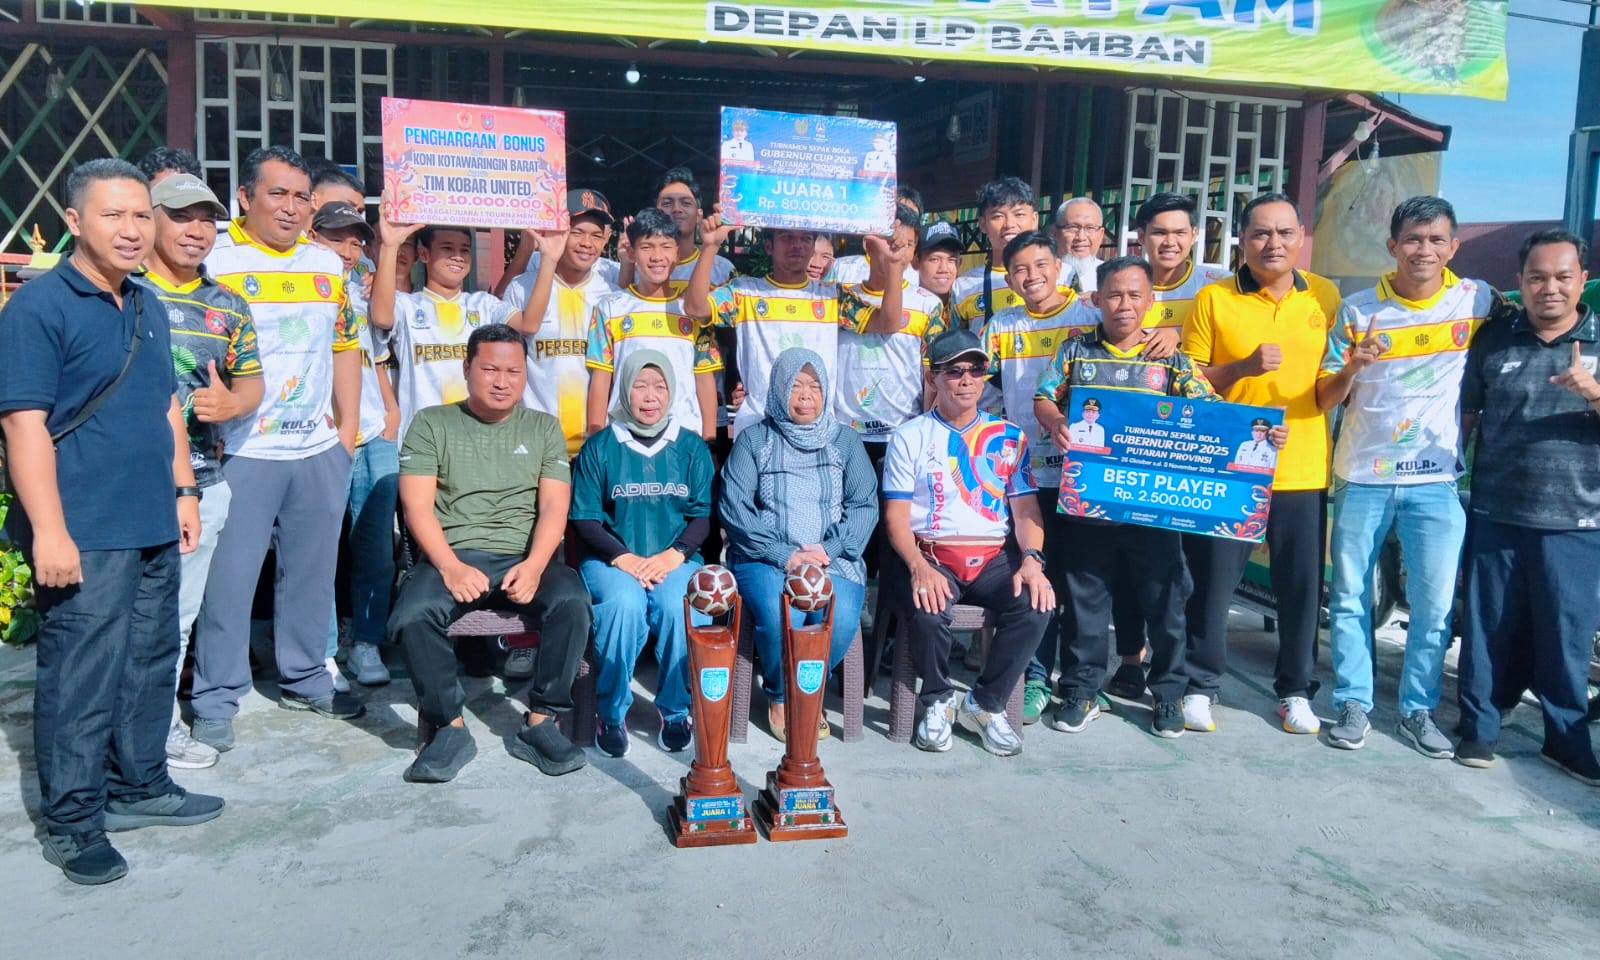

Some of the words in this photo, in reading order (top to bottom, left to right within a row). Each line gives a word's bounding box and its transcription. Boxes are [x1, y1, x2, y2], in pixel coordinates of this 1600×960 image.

[714, 5, 898, 42] DEPAN
[915, 20, 976, 47] LP
[991, 25, 1206, 64] BAMBAN
[405, 127, 497, 150] PENGHARGAAN
[503, 135, 545, 153] BONUS
[413, 152, 436, 166] KONI
[437, 154, 508, 171] KOTAWARINGIN
[510, 159, 539, 173] BARAT
[760, 149, 812, 161] GUBERNUR
[813, 153, 833, 162] CUP
[834, 155, 859, 165] 2025
[424, 175, 444, 191] TIM
[447, 177, 488, 194] KOBAR
[490, 180, 531, 196] UNITED
[771, 180, 835, 199] JUARA
[839, 185, 848, 200] 1
[411, 193, 442, 206] Rp.
[447, 195, 542, 210] 10.000.000
[758, 197, 778, 210] Rp.
[782, 199, 859, 214] 80.000.000
[454, 209, 478, 217] JUARA
[1112, 433, 1174, 450] GUBERNUR
[1174, 441, 1199, 452] CUP
[1198, 444, 1230, 457] 2025
[1124, 426, 1169, 438] TURNAMEN
[1169, 431, 1196, 441] SEPAK
[1198, 434, 1220, 444] BOLA
[1126, 446, 1168, 459] PUTARAN
[1169, 452, 1213, 465] PROVINSI
[611, 482, 689, 499] ADIDAS
[1103, 467, 1150, 489] BEST
[1154, 473, 1228, 498] PLAYER
[929, 471, 945, 531] POPNAS
[1113, 487, 1135, 502] Rp.
[1138, 489, 1213, 511] 2.500.000
[701, 808, 726, 817] JUARA
